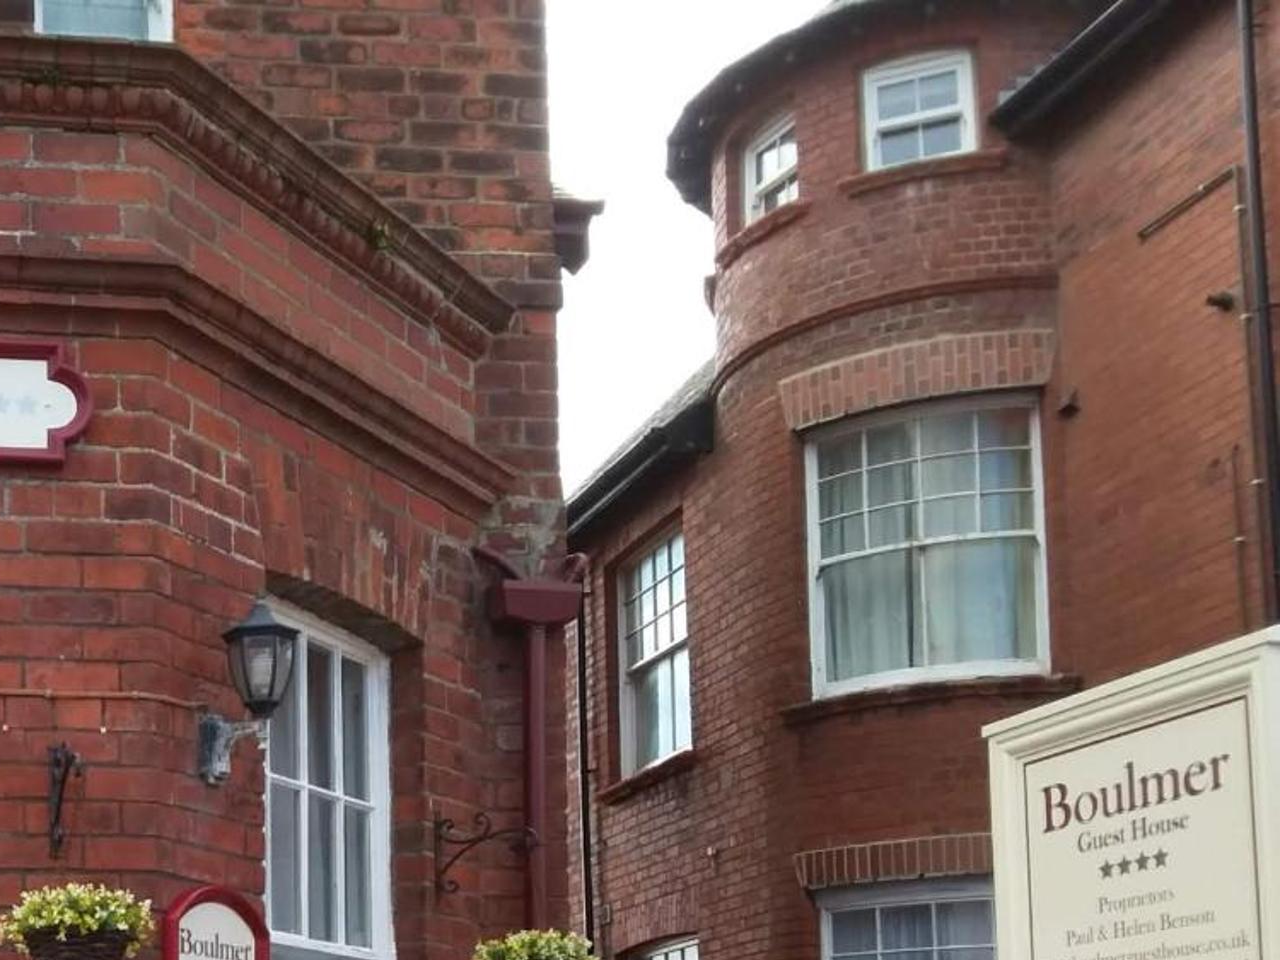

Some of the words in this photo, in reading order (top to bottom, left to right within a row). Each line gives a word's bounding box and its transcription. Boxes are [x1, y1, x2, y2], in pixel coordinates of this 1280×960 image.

[1041, 753, 1230, 834] Boulmer
[1078, 828, 1125, 853] Guest
[1131, 814, 1190, 841] House
[1098, 888, 1176, 914] Proprietors
[1066, 927, 1094, 947] Paul
[1097, 925, 1109, 943] &
[1113, 918, 1157, 940] Helen
[1160, 909, 1216, 932] Benson
